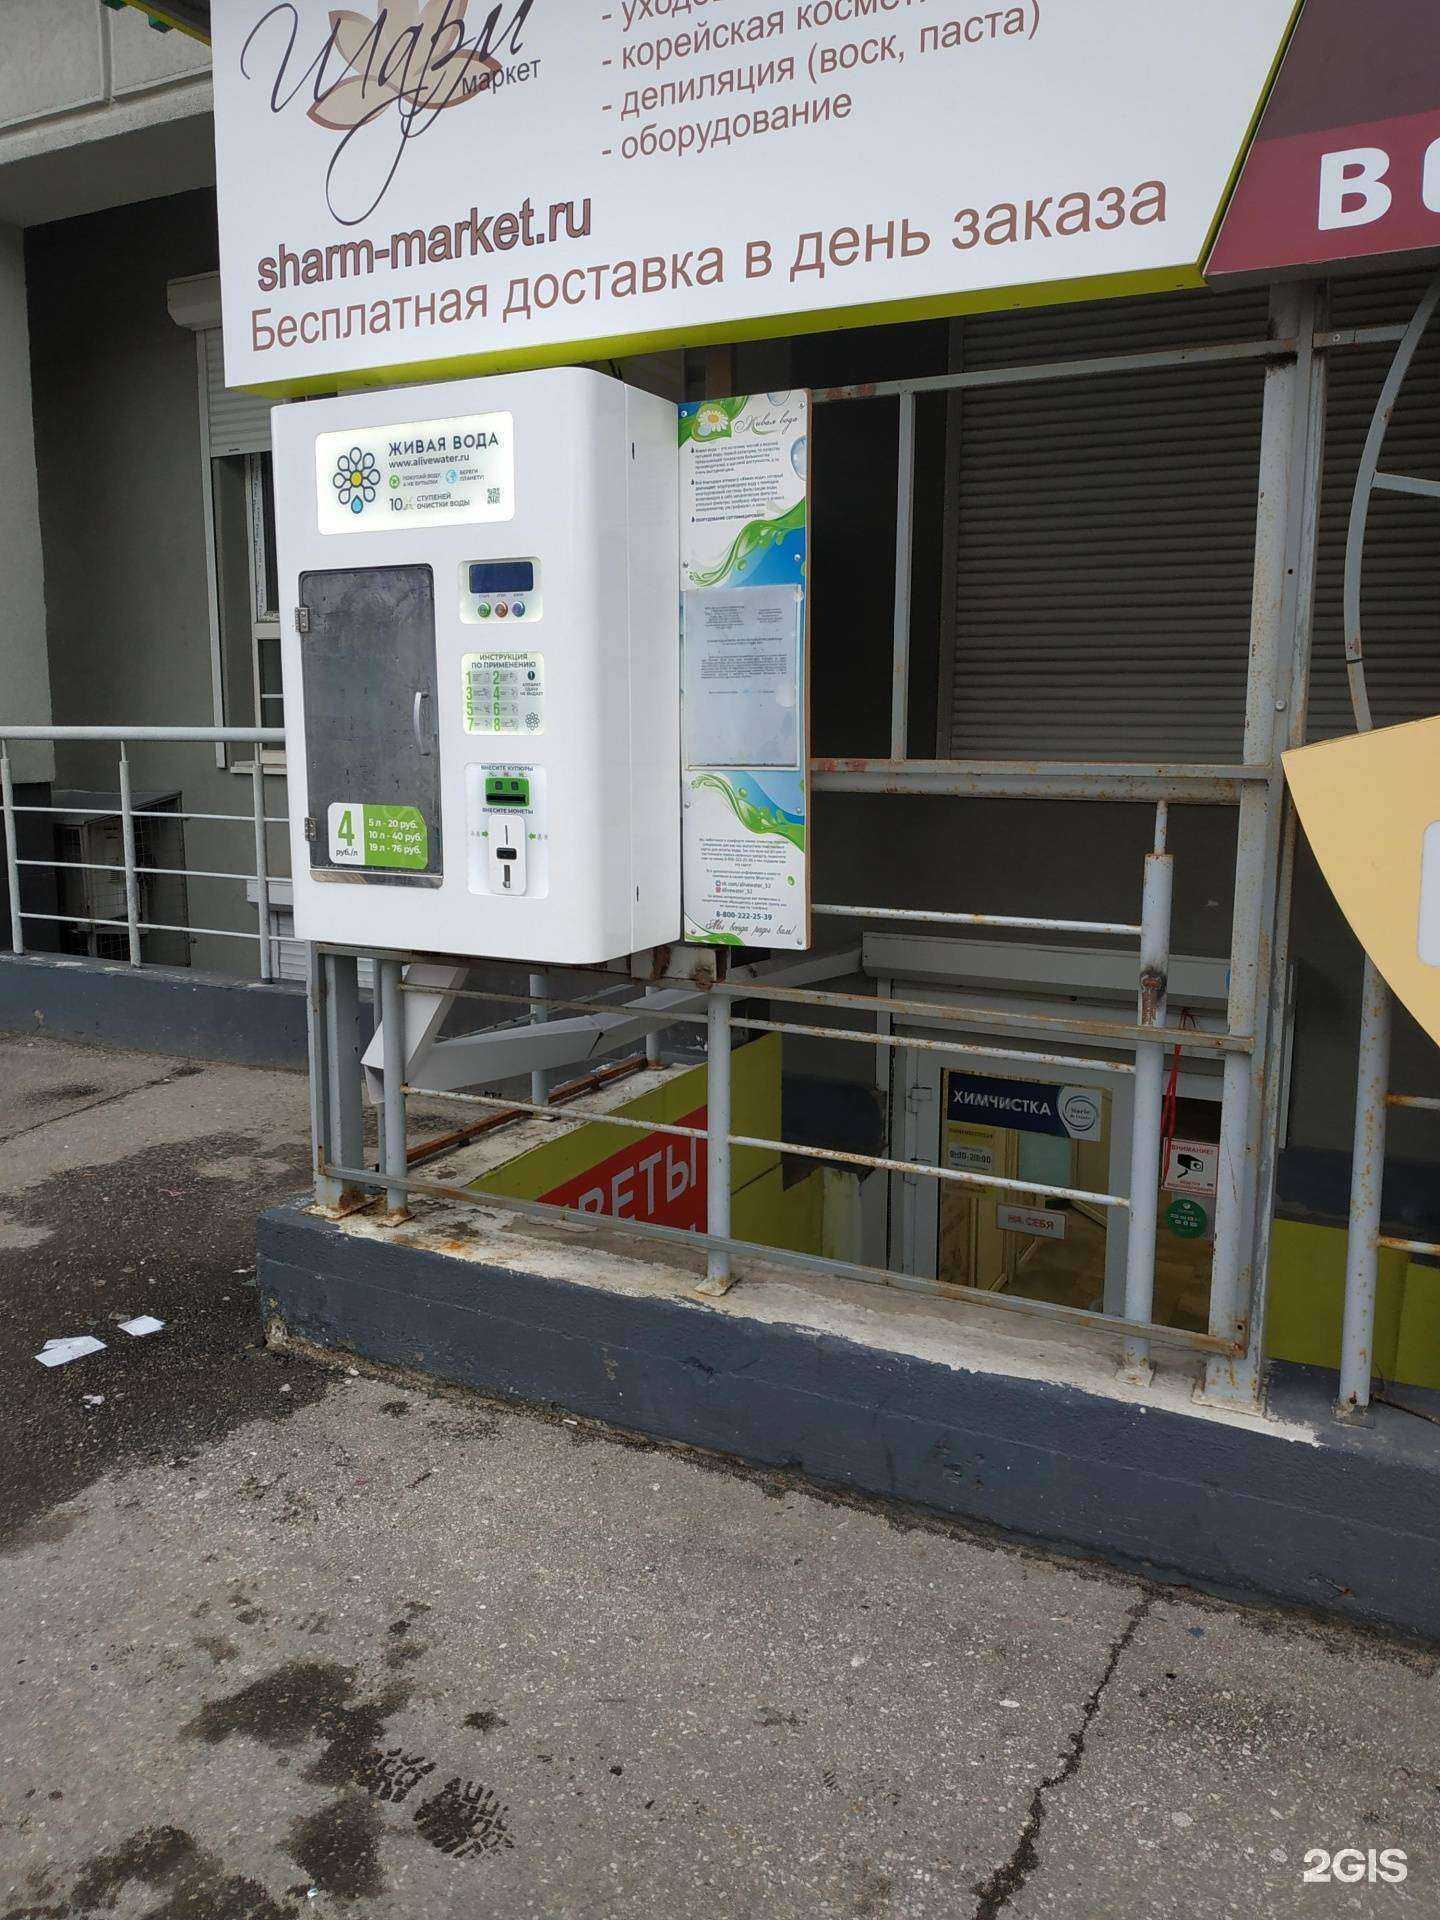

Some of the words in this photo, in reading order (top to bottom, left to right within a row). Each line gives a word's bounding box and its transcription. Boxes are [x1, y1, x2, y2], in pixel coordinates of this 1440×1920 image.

[623, 0, 708, 32] уход
[622, 10, 784, 70] корейская
[621, 56, 795, 120] депиляция
[807, 34, 904, 84] (воск,
[919, 0, 1041, 54] паста)
[462, 59, 541, 96] маркет
[621, 92, 852, 159] оборудование
[257, 197, 592, 292] sharm-market.ru
[250, 283, 487, 352] Бесплатная
[502, 246, 725, 323] доставка
[746, 239, 772, 278] в
[789, 217, 931, 282] день
[951, 178, 1168, 251] заказа
[388, 437, 446, 457] ЖИВАЯ
[453, 432, 499, 451] ВОДА
[388, 453, 470, 469] www.alivewater.ru
[416, 491, 451, 502] СТУПЕНЕЙ
[390, 497, 403, 512] 10
[416, 501, 448, 510] ОЧИСТКИ
[450, 499, 471, 509] ВОДЫ
[479, 653, 528, 661] ИНСТРУКЦИЯ
[484, 661, 536, 669] ПРИМЕНЕНИЮ
[466, 671, 472, 685] 1
[492, 670, 500, 685] 2
[466, 687, 473, 700] 3
[493, 687, 500, 701] 4
[466, 702, 473, 716] 5
[493, 702, 501, 716] 6
[467, 717, 474, 731] 7
[494, 717, 501, 732] 8
[337, 810, 355, 847] 4
[368, 818, 375, 827] 5
[388, 819, 398, 828] 20
[400, 819, 418, 830] руб.
[368, 830, 378, 839] 10
[392, 831, 403, 841] 40
[405, 832, 422, 843] руб.
[368, 842, 378, 852] 19
[391, 843, 403, 853] 76
[404, 845, 422, 856] руб.
[716, 910, 773, 921] 8-800-222-25-39
[953, 1088, 1051, 1117] ХИМЧИСТКА
[1025, 1214, 1054, 1230] СЕБЯ
